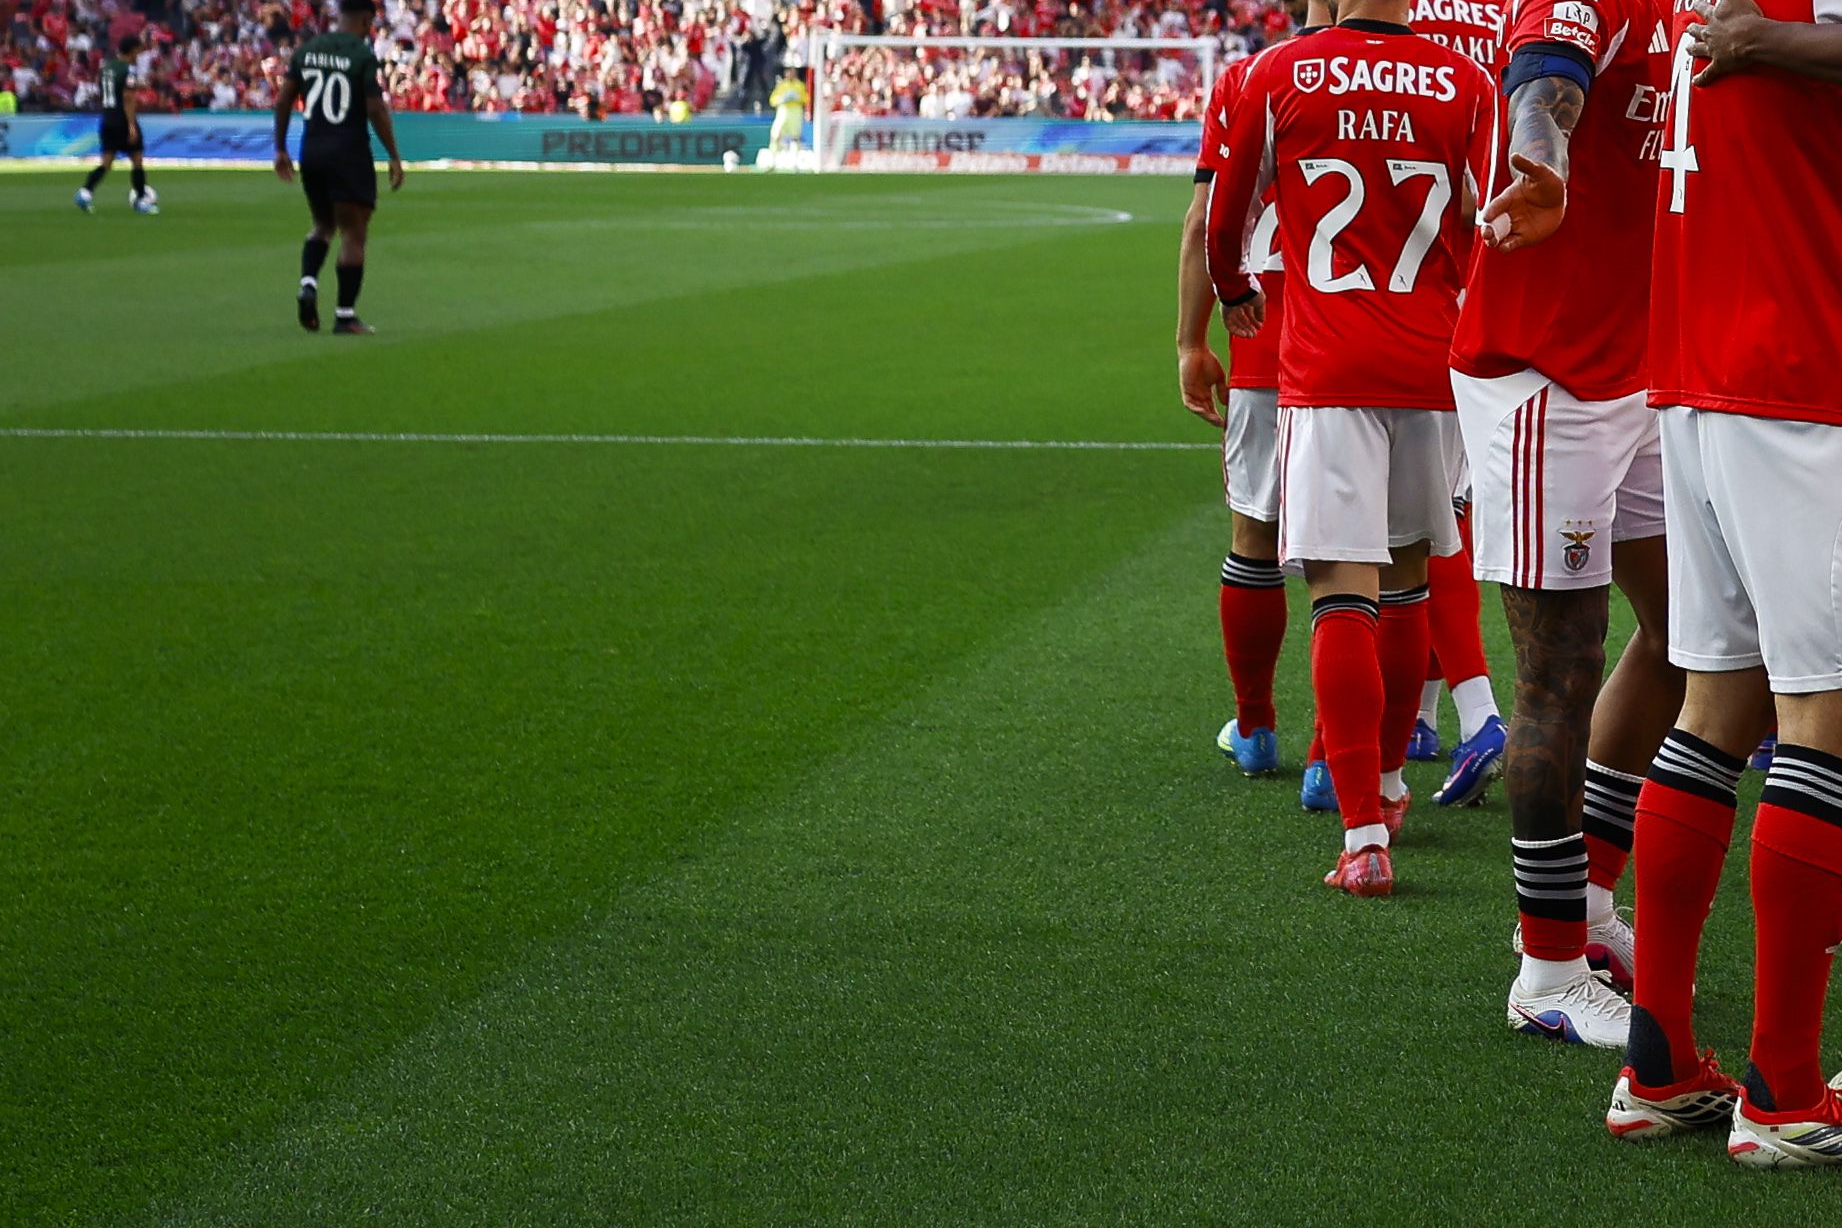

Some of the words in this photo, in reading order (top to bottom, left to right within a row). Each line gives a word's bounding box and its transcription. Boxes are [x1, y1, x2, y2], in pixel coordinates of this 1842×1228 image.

[301, 68, 352, 124] 70
[1328, 56, 1457, 103] SAGRES
[541, 129, 746, 159] PREDATOR
[1337, 108, 1416, 142] RAFA
[1298, 158, 1452, 294] 27
